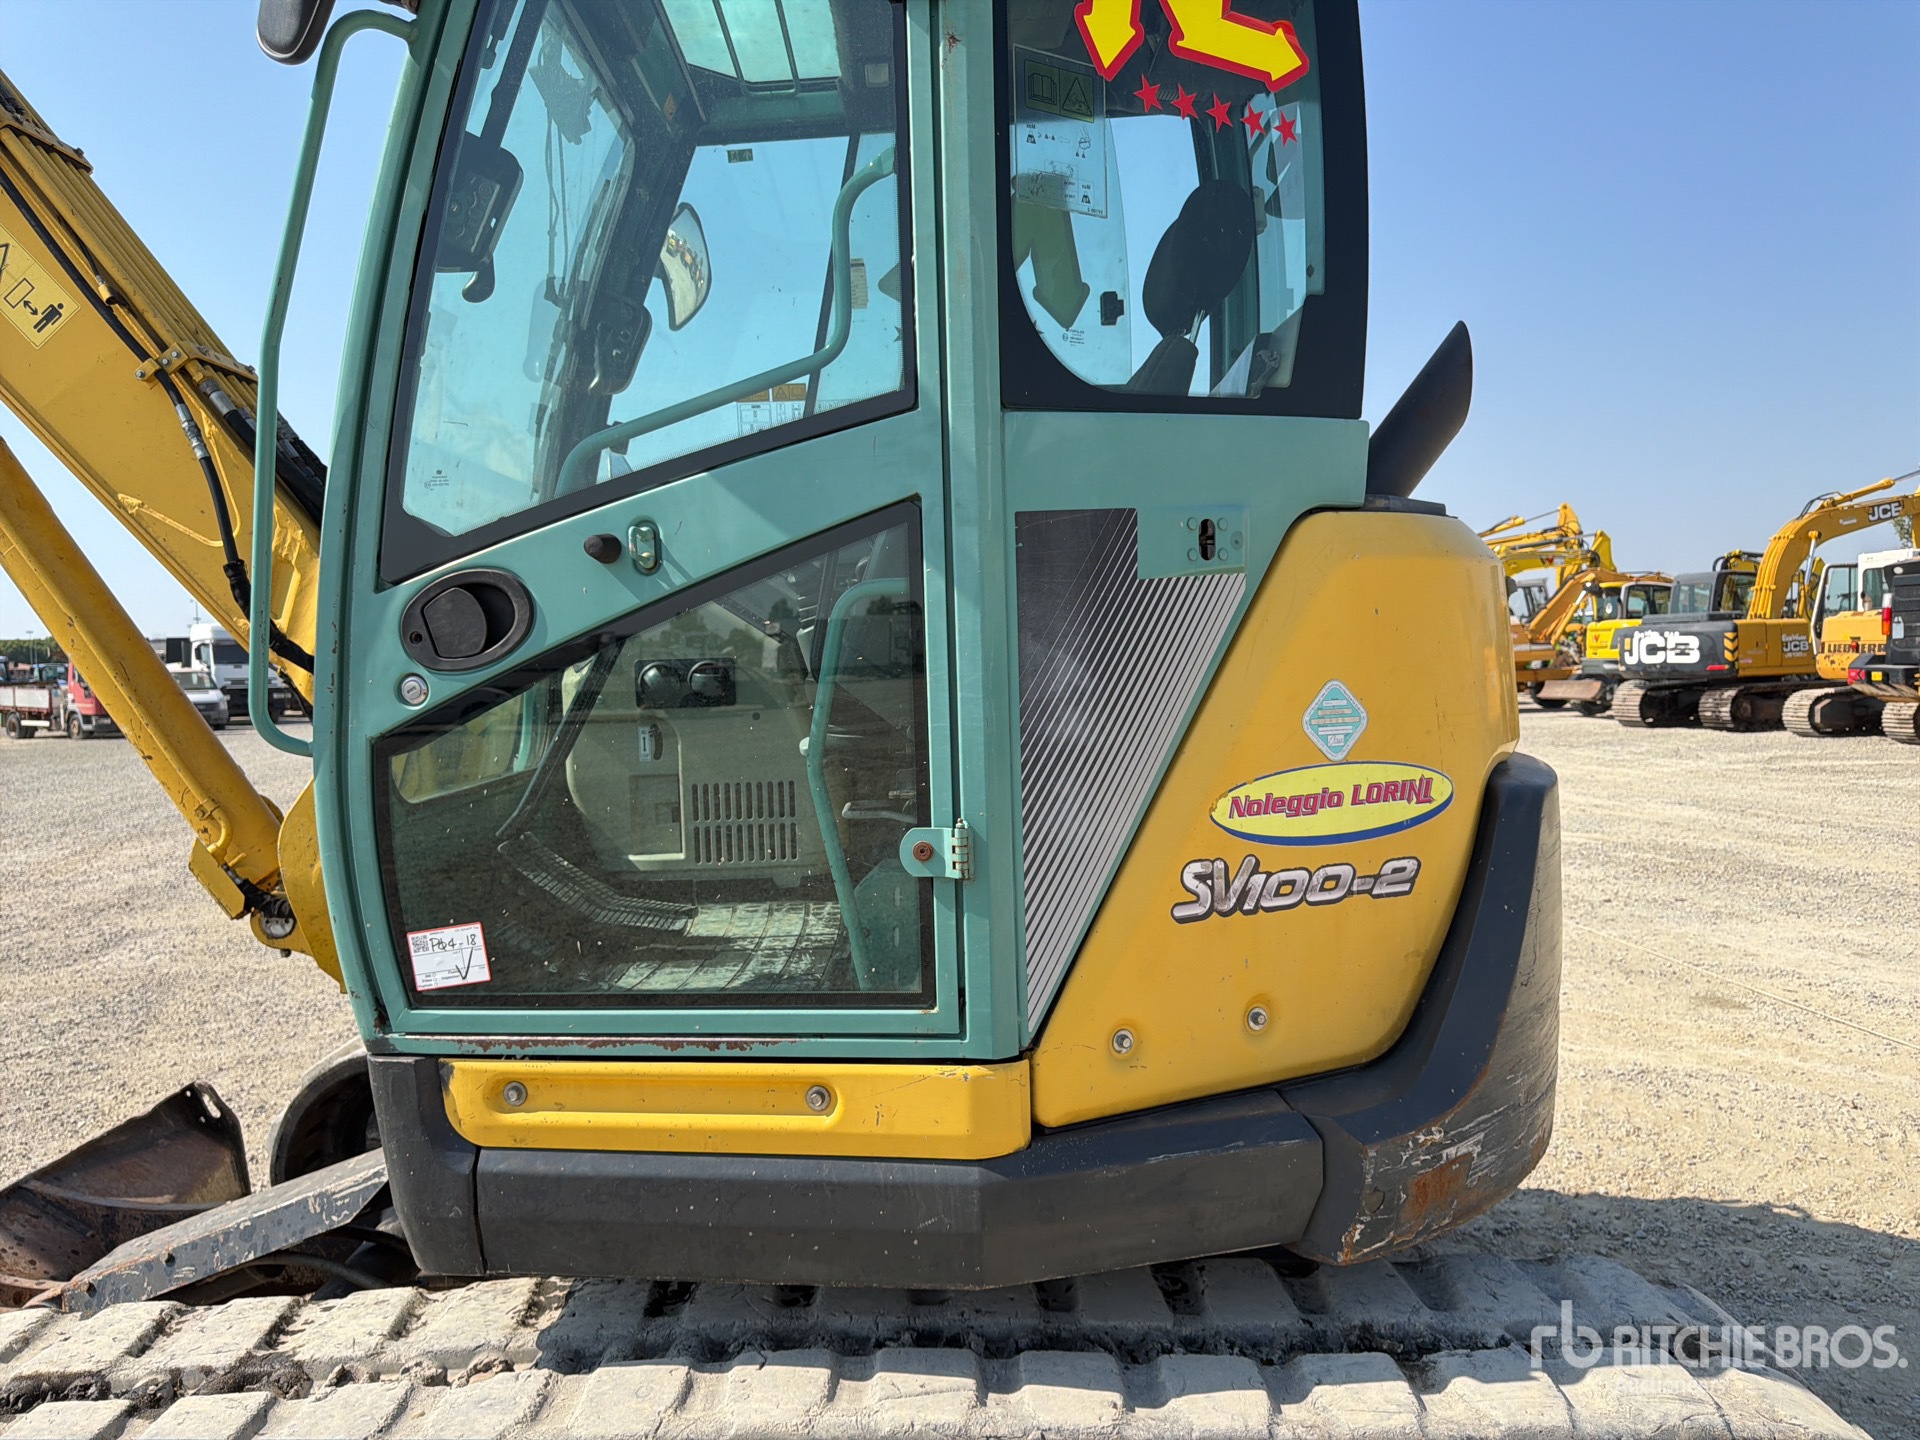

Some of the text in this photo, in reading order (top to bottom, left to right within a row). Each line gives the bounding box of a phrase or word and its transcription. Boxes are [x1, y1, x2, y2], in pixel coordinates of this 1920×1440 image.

[1624, 633, 1701, 665] JCB
[1782, 641, 1809, 652] JCB
[1228, 773, 1435, 819] Noleggio LORINI
[1170, 854, 1421, 925] SV100-2
